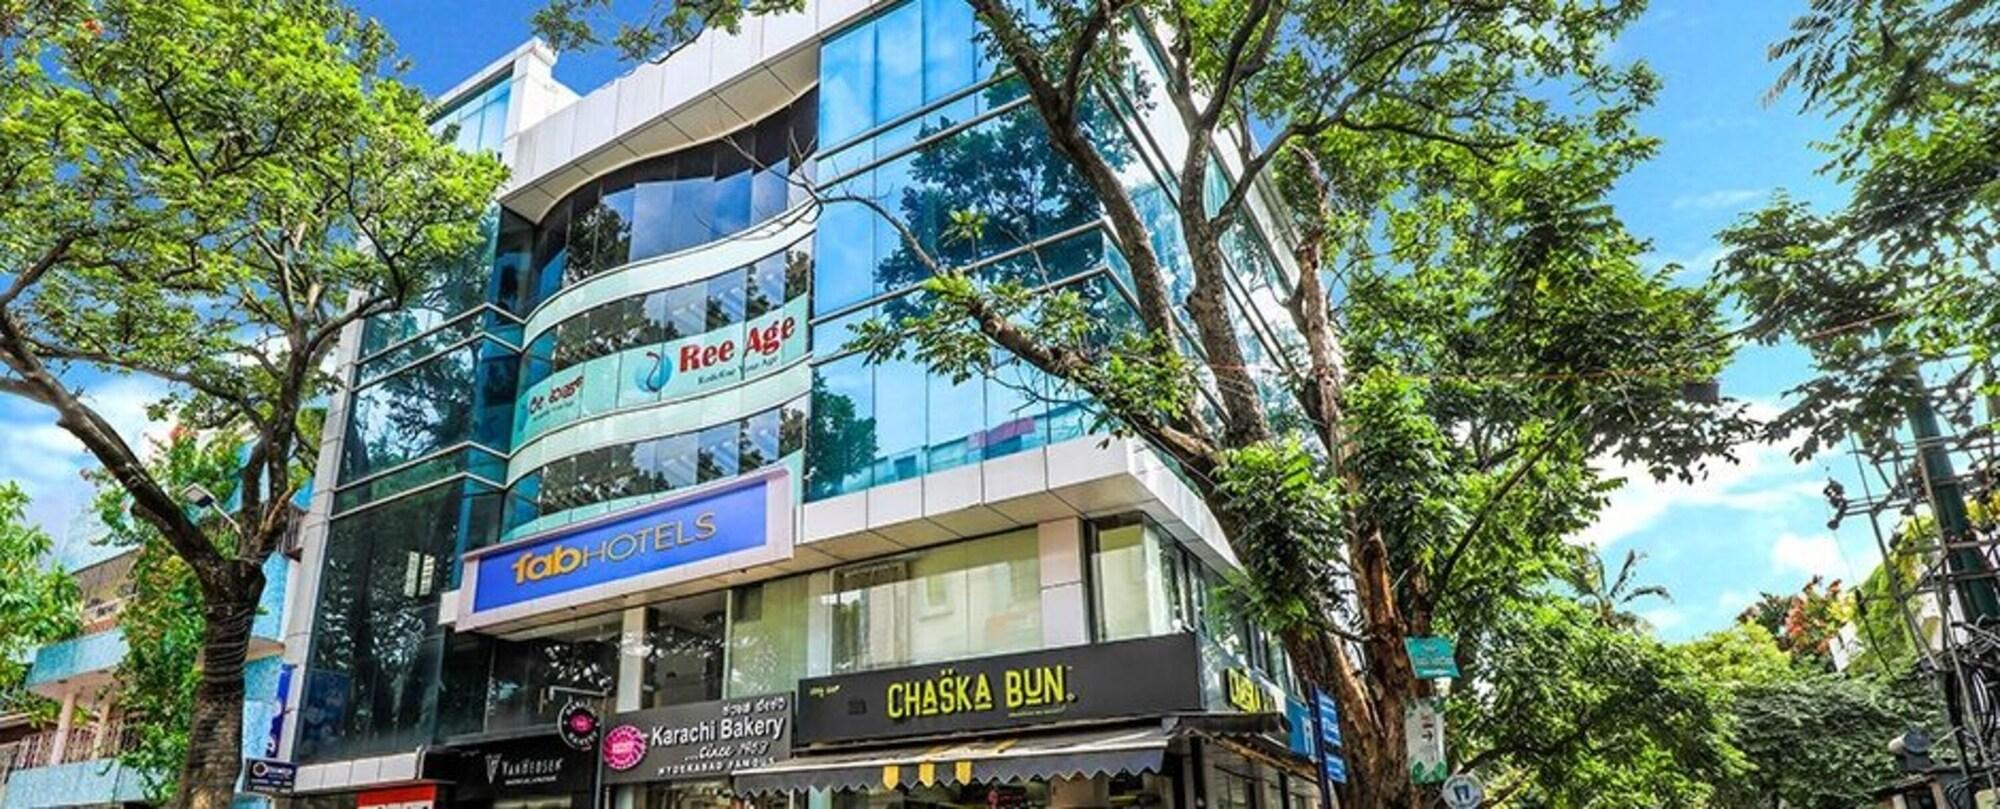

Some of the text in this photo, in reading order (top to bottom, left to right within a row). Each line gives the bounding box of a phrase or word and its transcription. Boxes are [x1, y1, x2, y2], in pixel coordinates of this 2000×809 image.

[679, 316, 795, 373] Ree Age
[512, 511, 717, 585] fabHOTELS
[1005, 665, 1065, 709] BUN
[651, 715, 785, 748] Karachi Bakery
